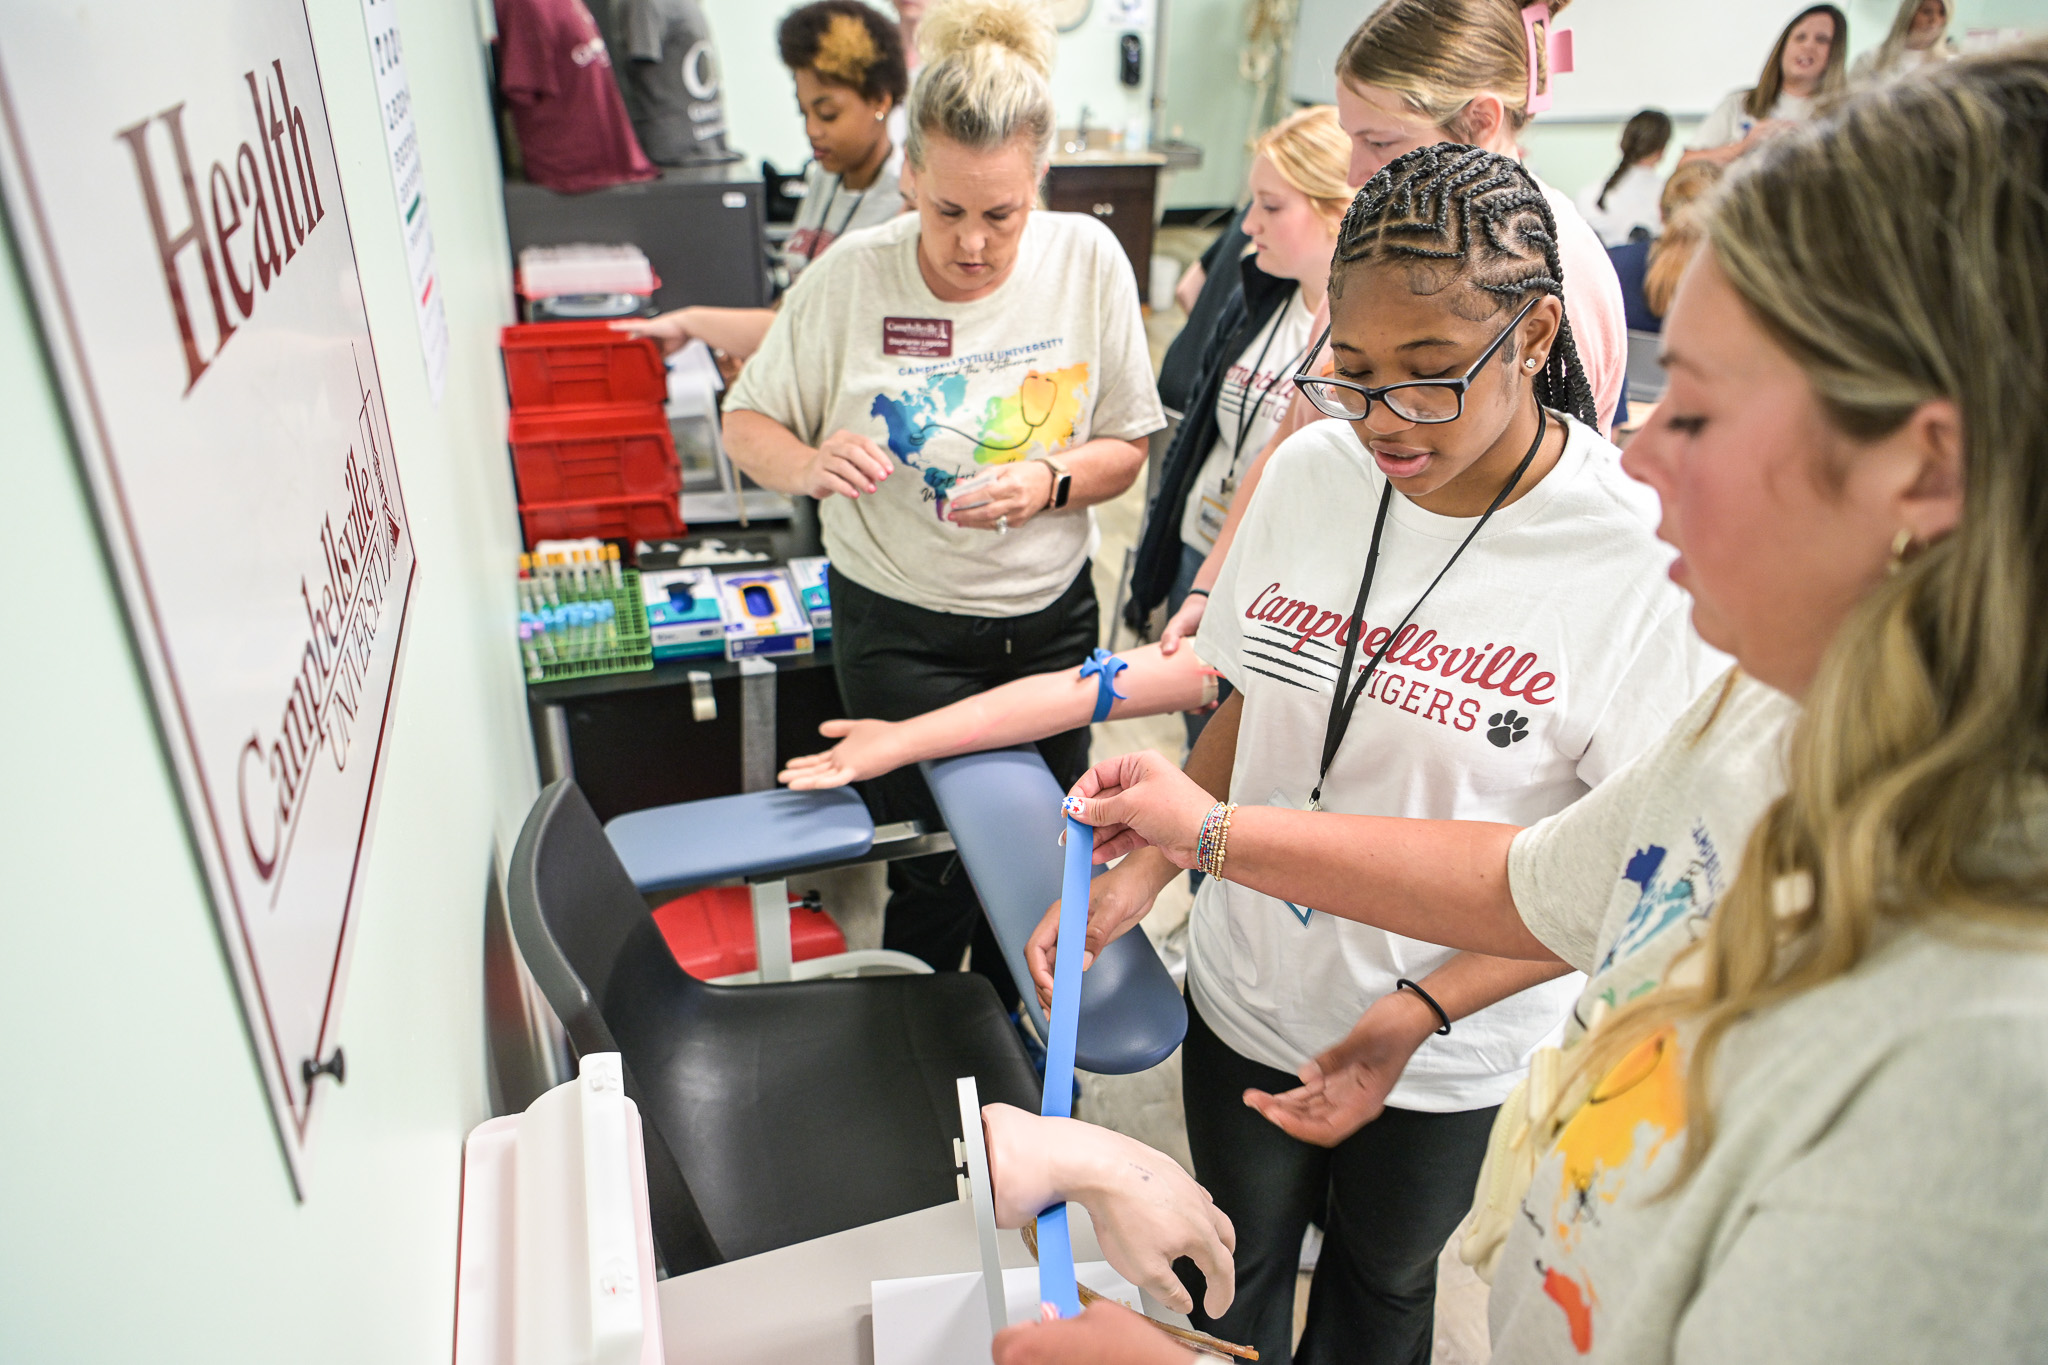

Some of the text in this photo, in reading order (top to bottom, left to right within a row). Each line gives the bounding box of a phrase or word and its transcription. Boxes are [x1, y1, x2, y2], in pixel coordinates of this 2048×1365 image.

[113, 58, 325, 401] Health
[997, 337, 1064, 360] UNIVERSITY
[237, 443, 374, 882] Campbellsville
[327, 528, 391, 773] UNIVERSITY
[1245, 582, 1556, 706] Campbellsville
